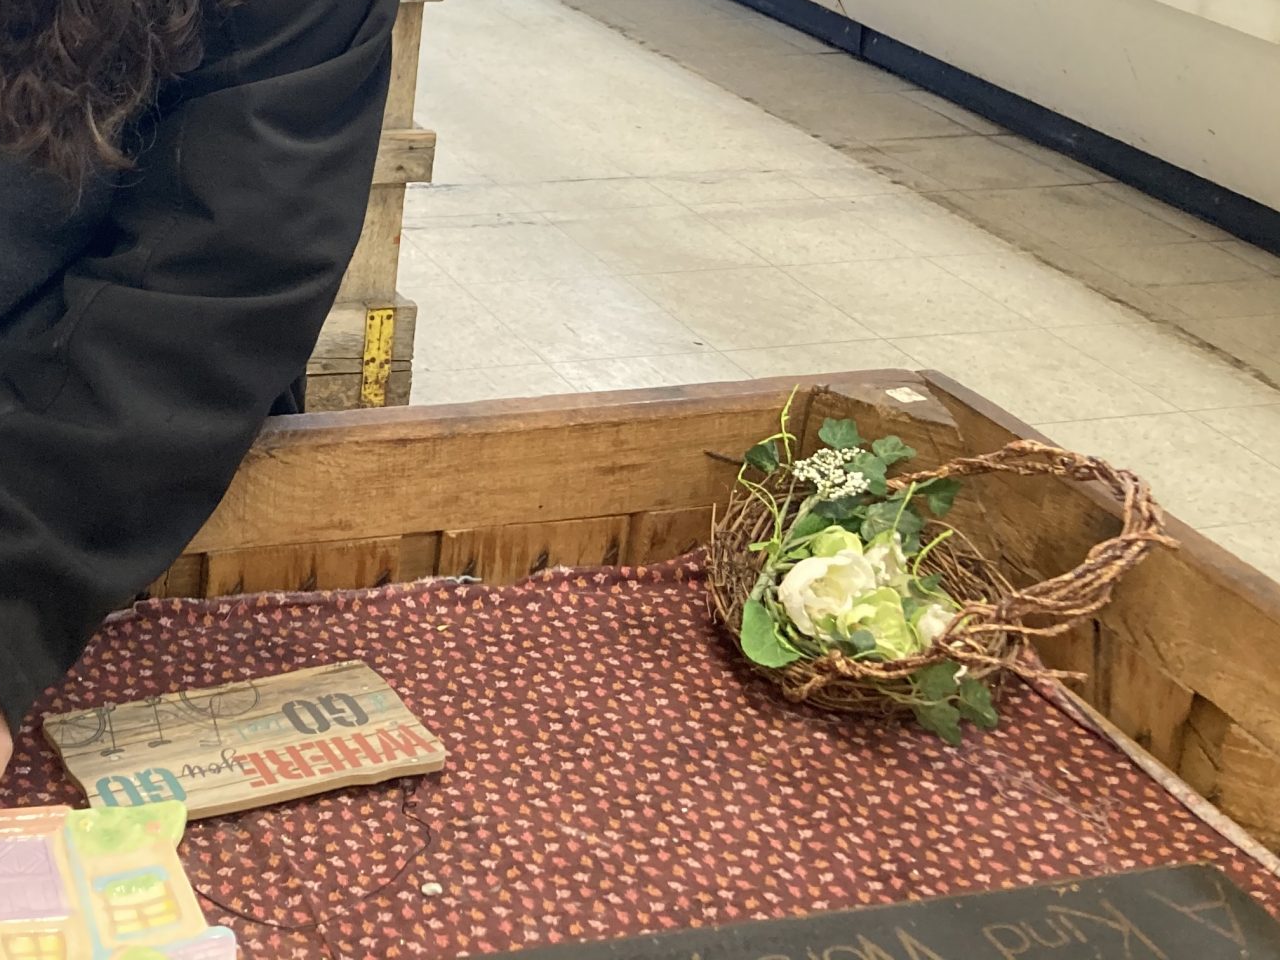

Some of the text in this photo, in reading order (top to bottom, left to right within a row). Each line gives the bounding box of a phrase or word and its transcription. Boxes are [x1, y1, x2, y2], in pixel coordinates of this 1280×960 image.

[281, 692, 370, 735] GO
[182, 747, 245, 779] you
[236, 724, 437, 788] WHERE
[95, 766, 188, 809] GO
